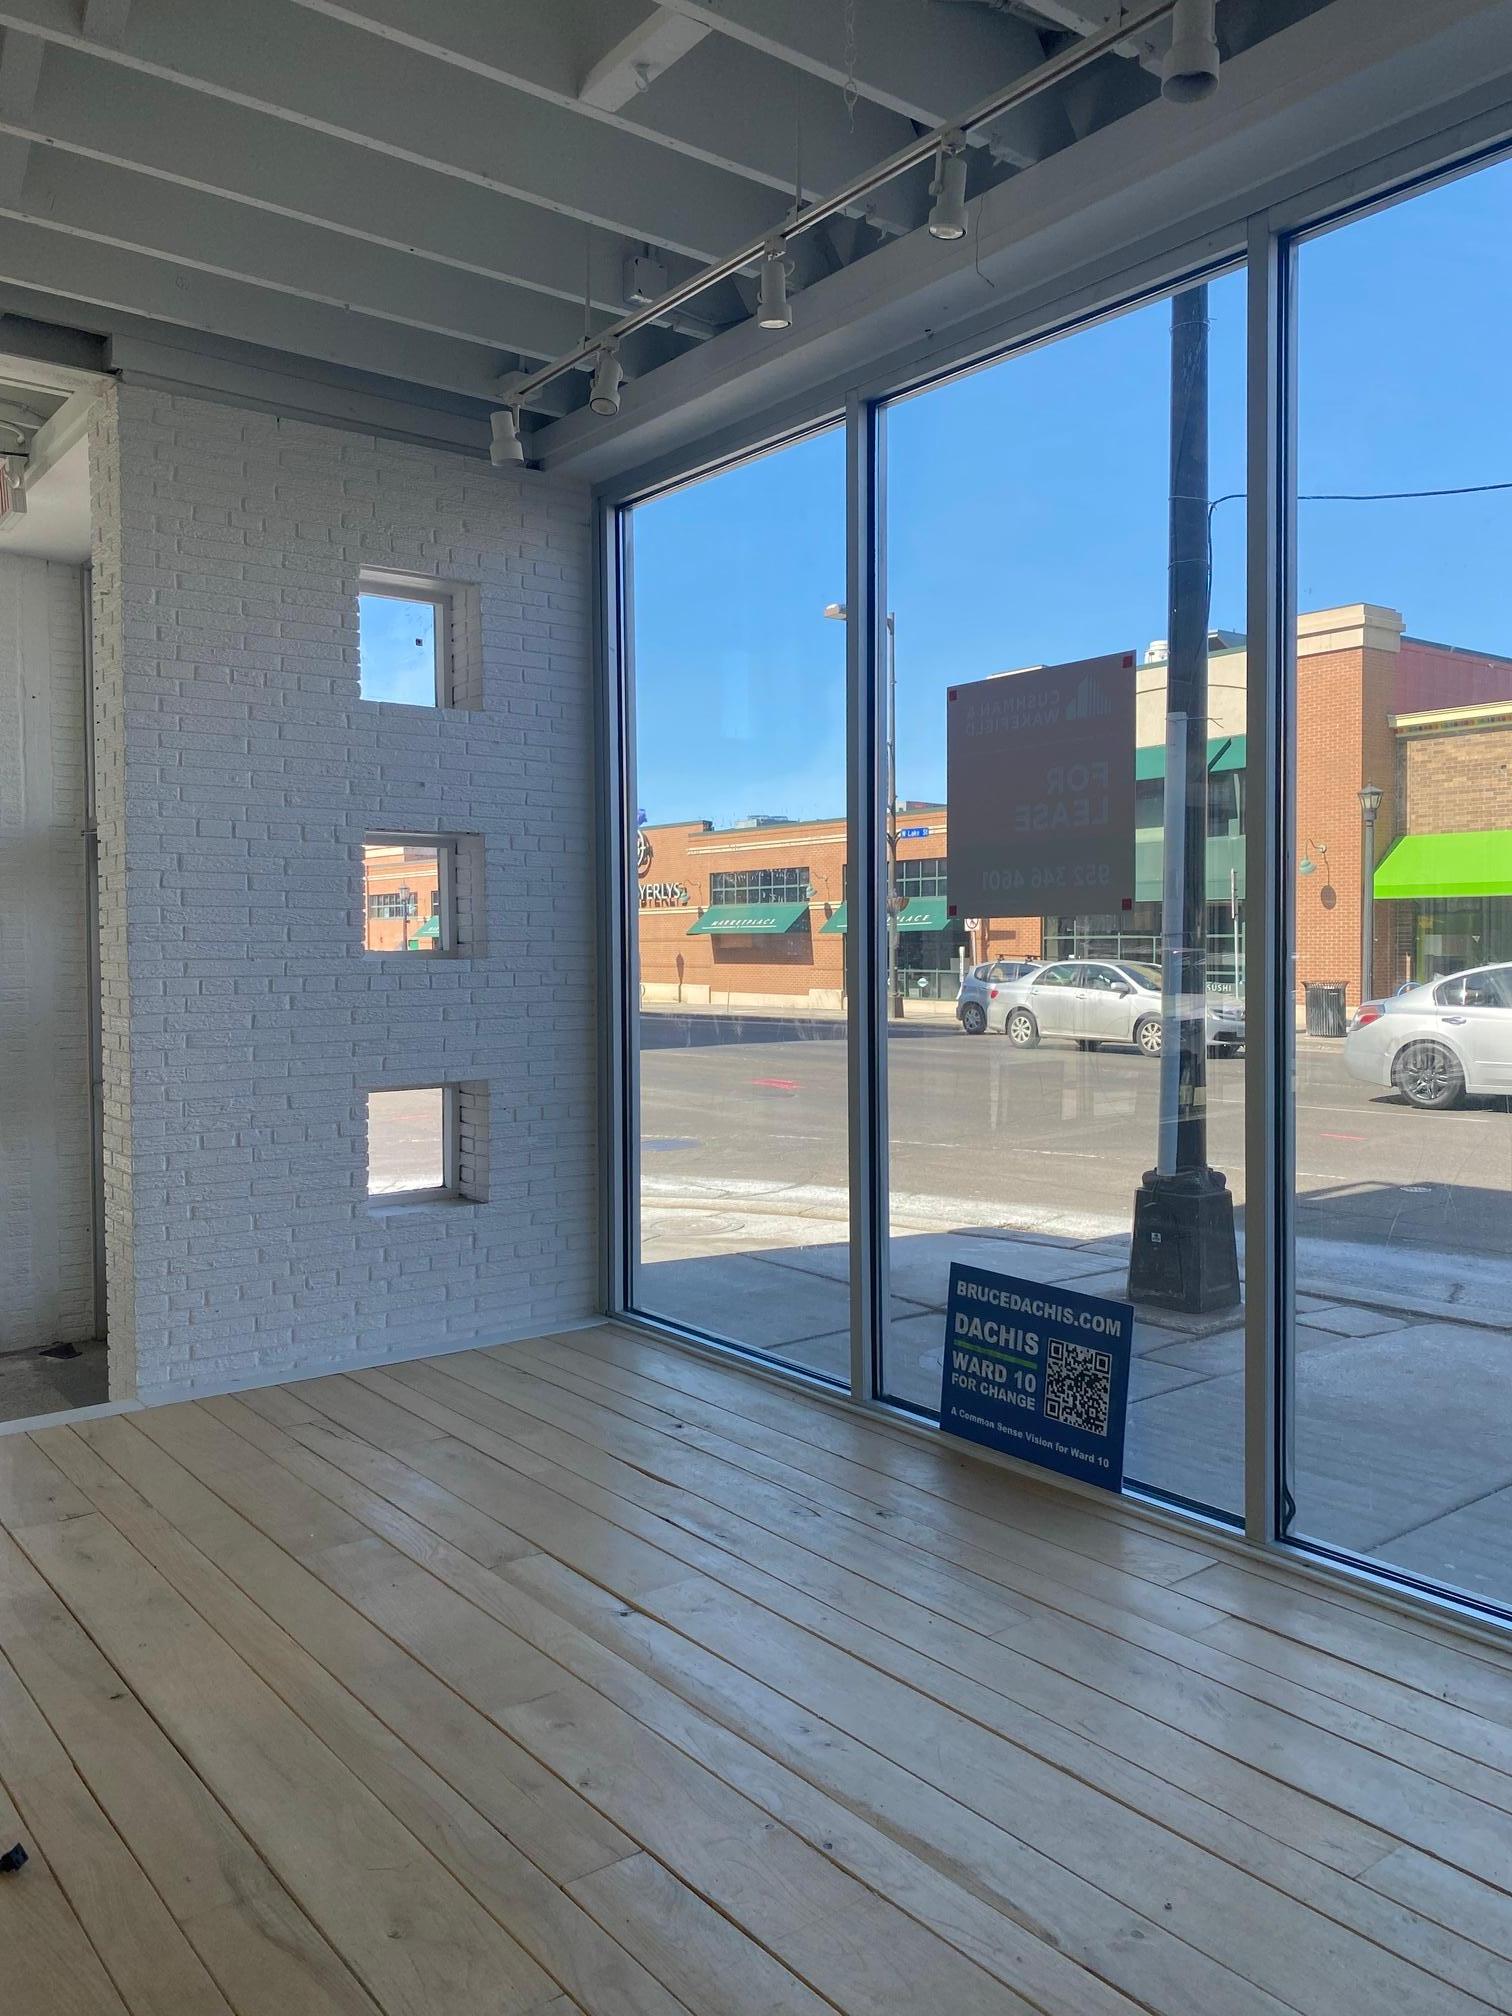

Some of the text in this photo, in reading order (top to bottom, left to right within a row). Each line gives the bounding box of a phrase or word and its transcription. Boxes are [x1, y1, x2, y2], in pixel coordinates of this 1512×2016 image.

[638, 882, 681, 900] YERLYS
[1207, 983, 1232, 992] SUSHI
[956, 1280, 1121, 1337] BRUCEDACHIS.COM
[954, 1312, 1039, 1356] DACHIS
[951, 1373, 1036, 1411] FOR CHANGE
[952, 1350, 1037, 1393] WARD 10
[951, 1406, 1110, 1469] A Common Sense Vision for Ward 10
